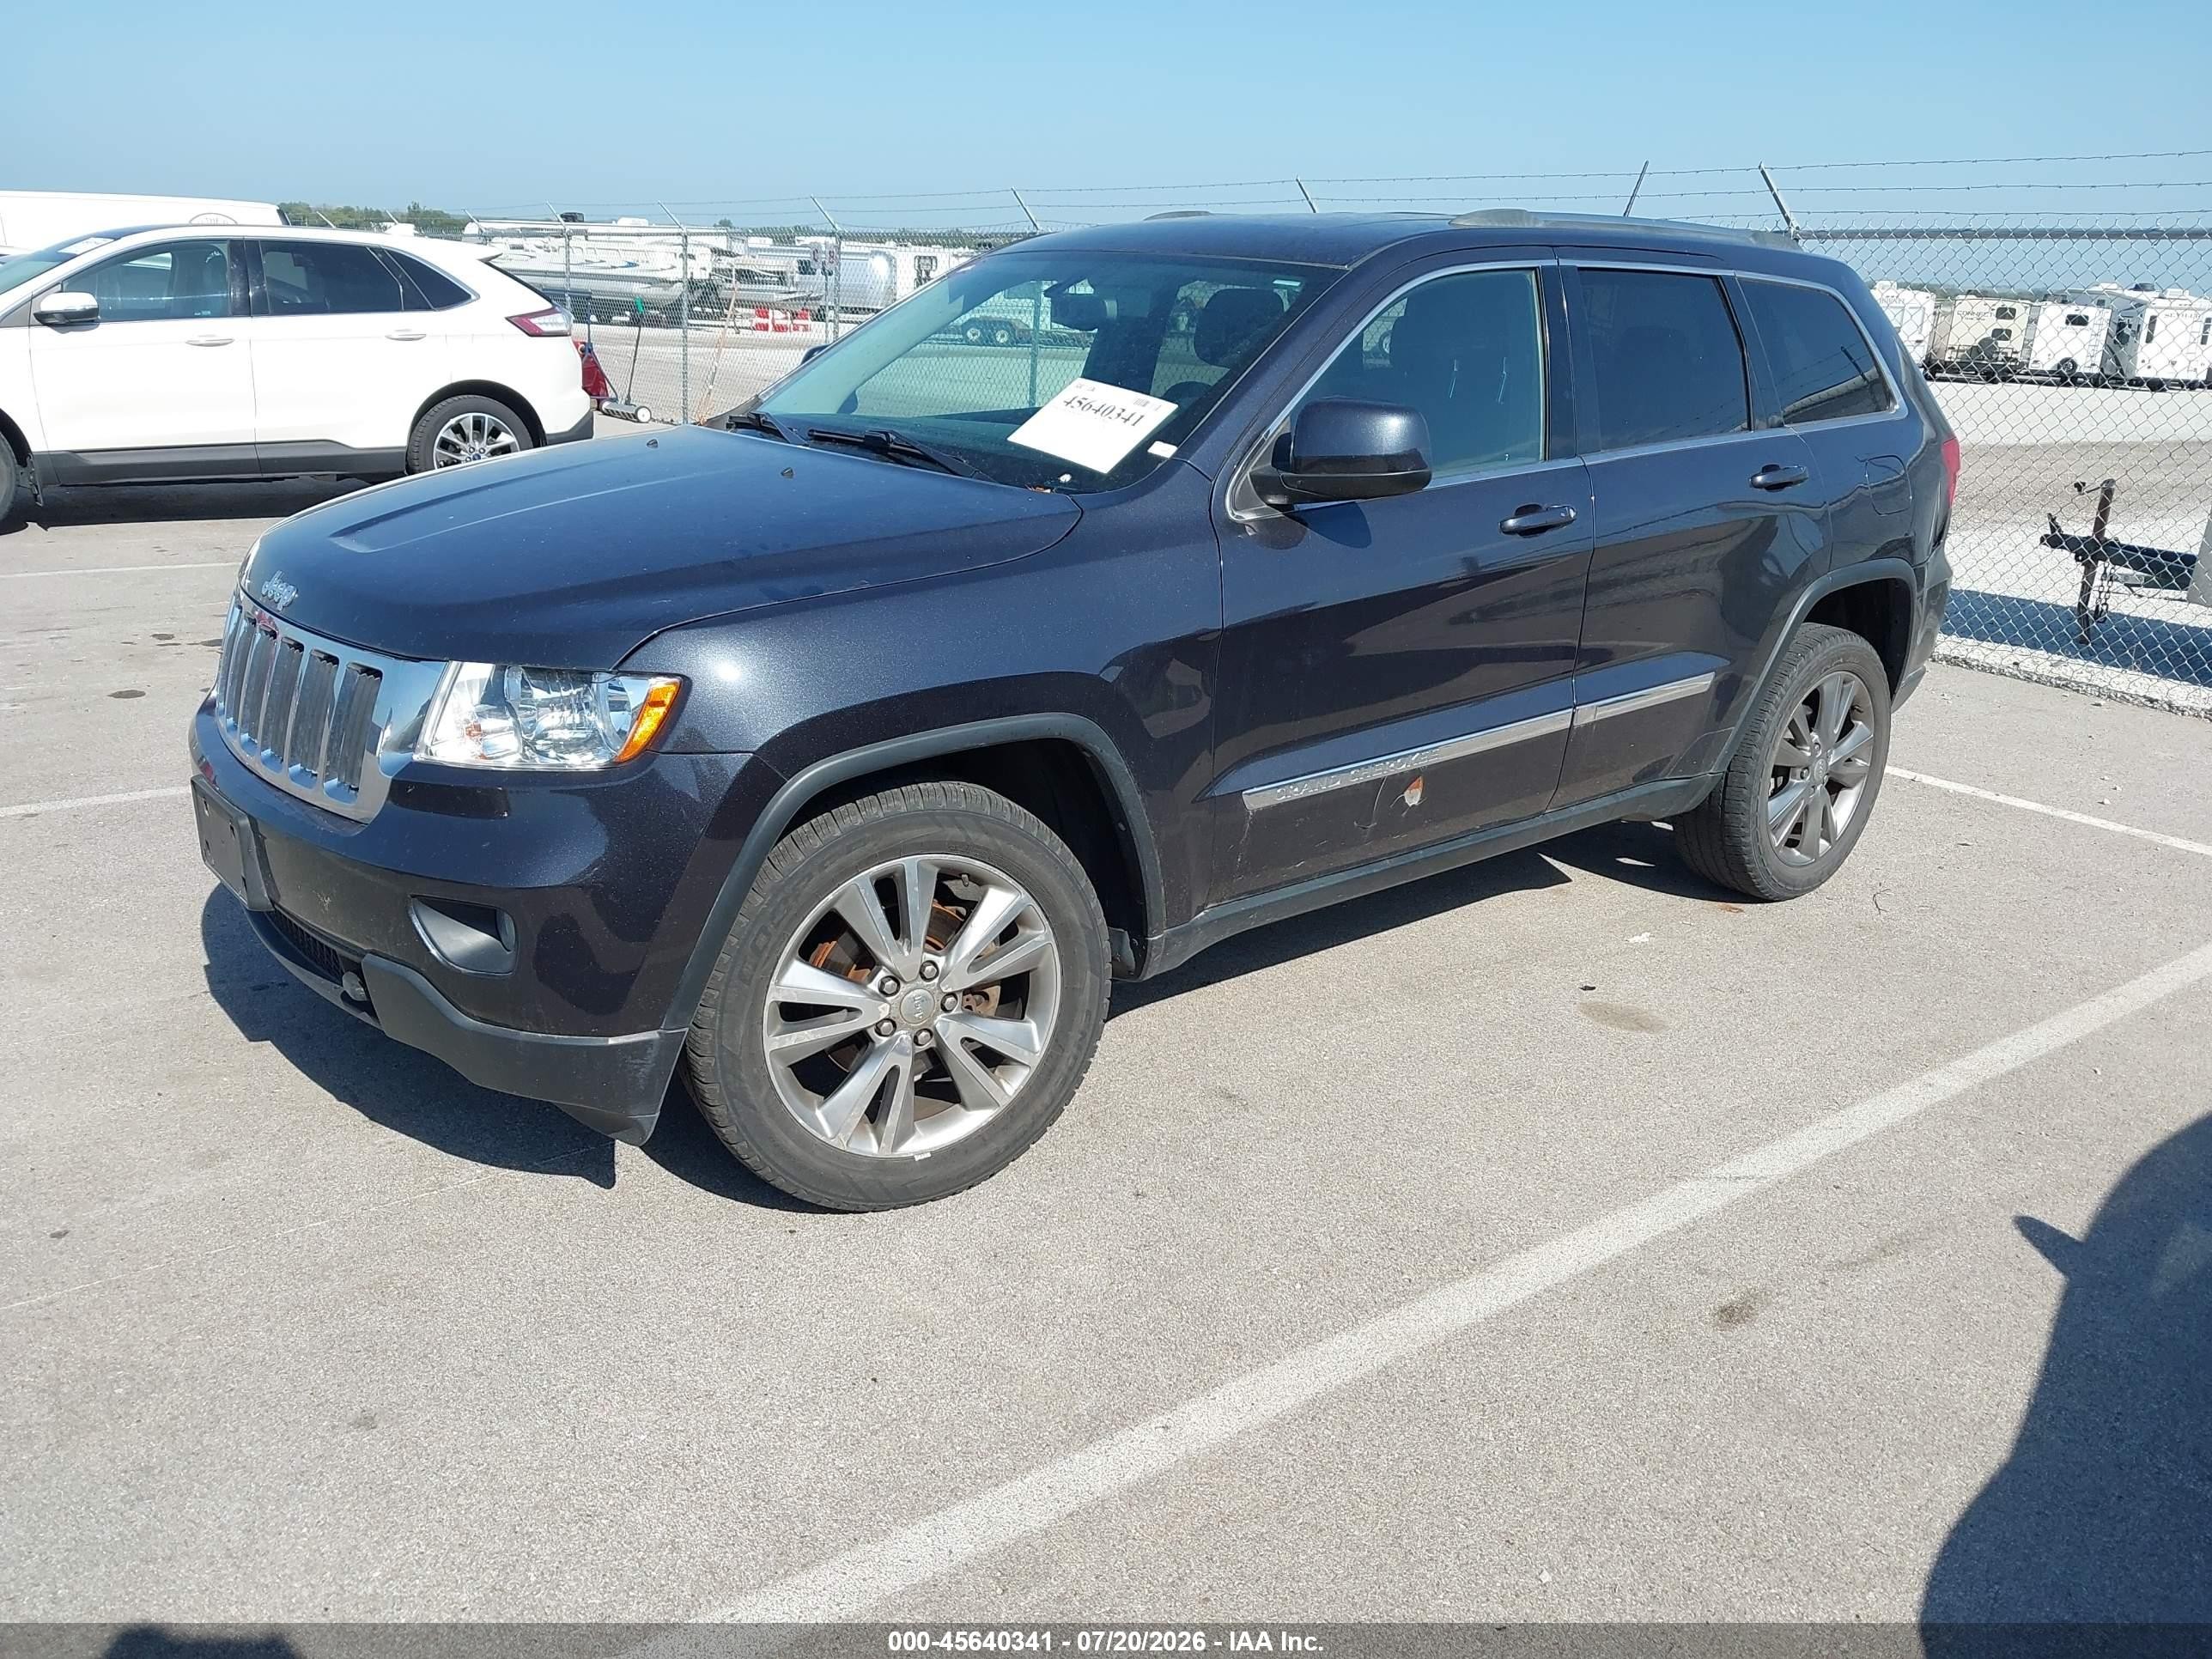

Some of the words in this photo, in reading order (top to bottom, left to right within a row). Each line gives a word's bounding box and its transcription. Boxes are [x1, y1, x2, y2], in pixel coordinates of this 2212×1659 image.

[1063, 395, 1145, 426] 45640341
[261, 569, 297, 611] Jeep
[1275, 775, 1341, 801] GRAND
[1350, 748, 1440, 782] CHEROKEE
